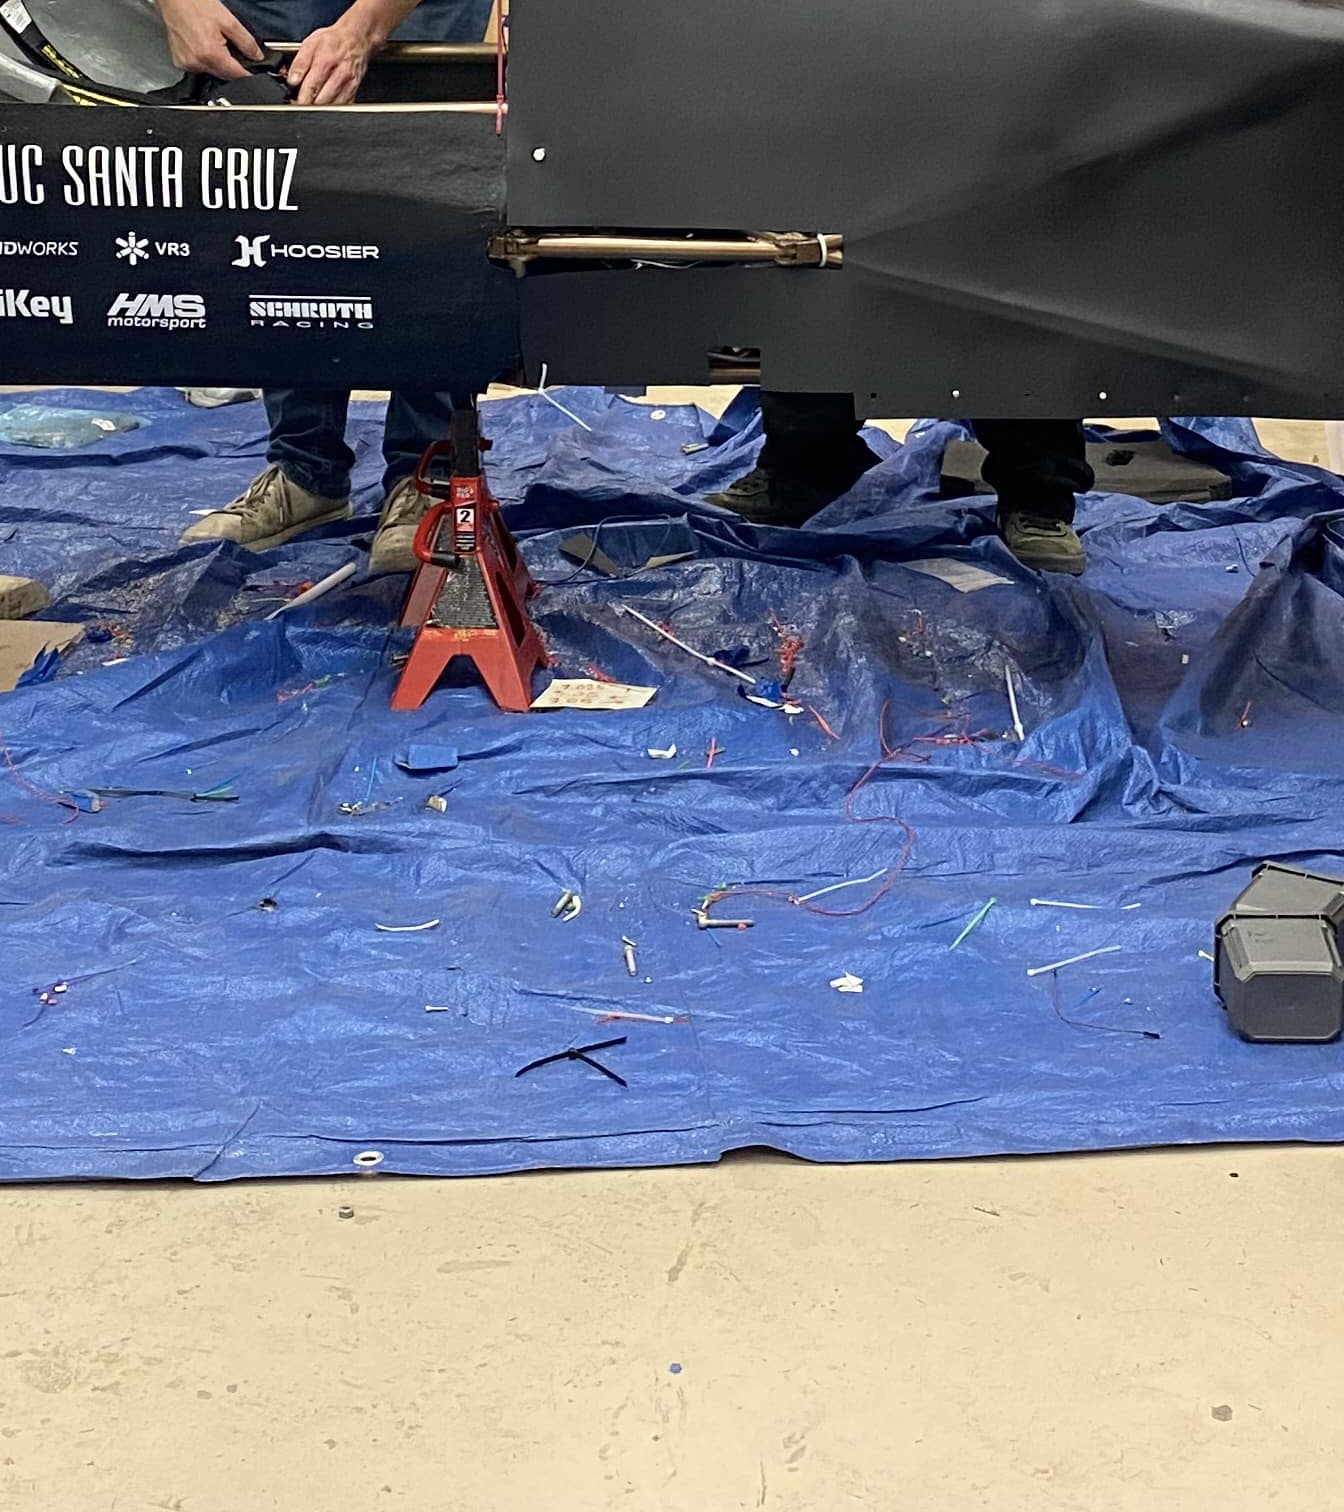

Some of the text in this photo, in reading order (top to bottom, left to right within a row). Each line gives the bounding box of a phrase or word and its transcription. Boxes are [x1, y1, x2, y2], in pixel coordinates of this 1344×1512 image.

[62, 145, 183, 208] SANTA
[202, 146, 298, 211] CRUZ
[154, 240, 191, 257] VR3
[270, 243, 380, 260] HOOSIER
[106, 292, 206, 317] HMS
[249, 301, 374, 320] SCHROTH
[107, 316, 206, 331] motorsport
[251, 319, 374, 329] RACING
[460, 510, 471, 523] 2
